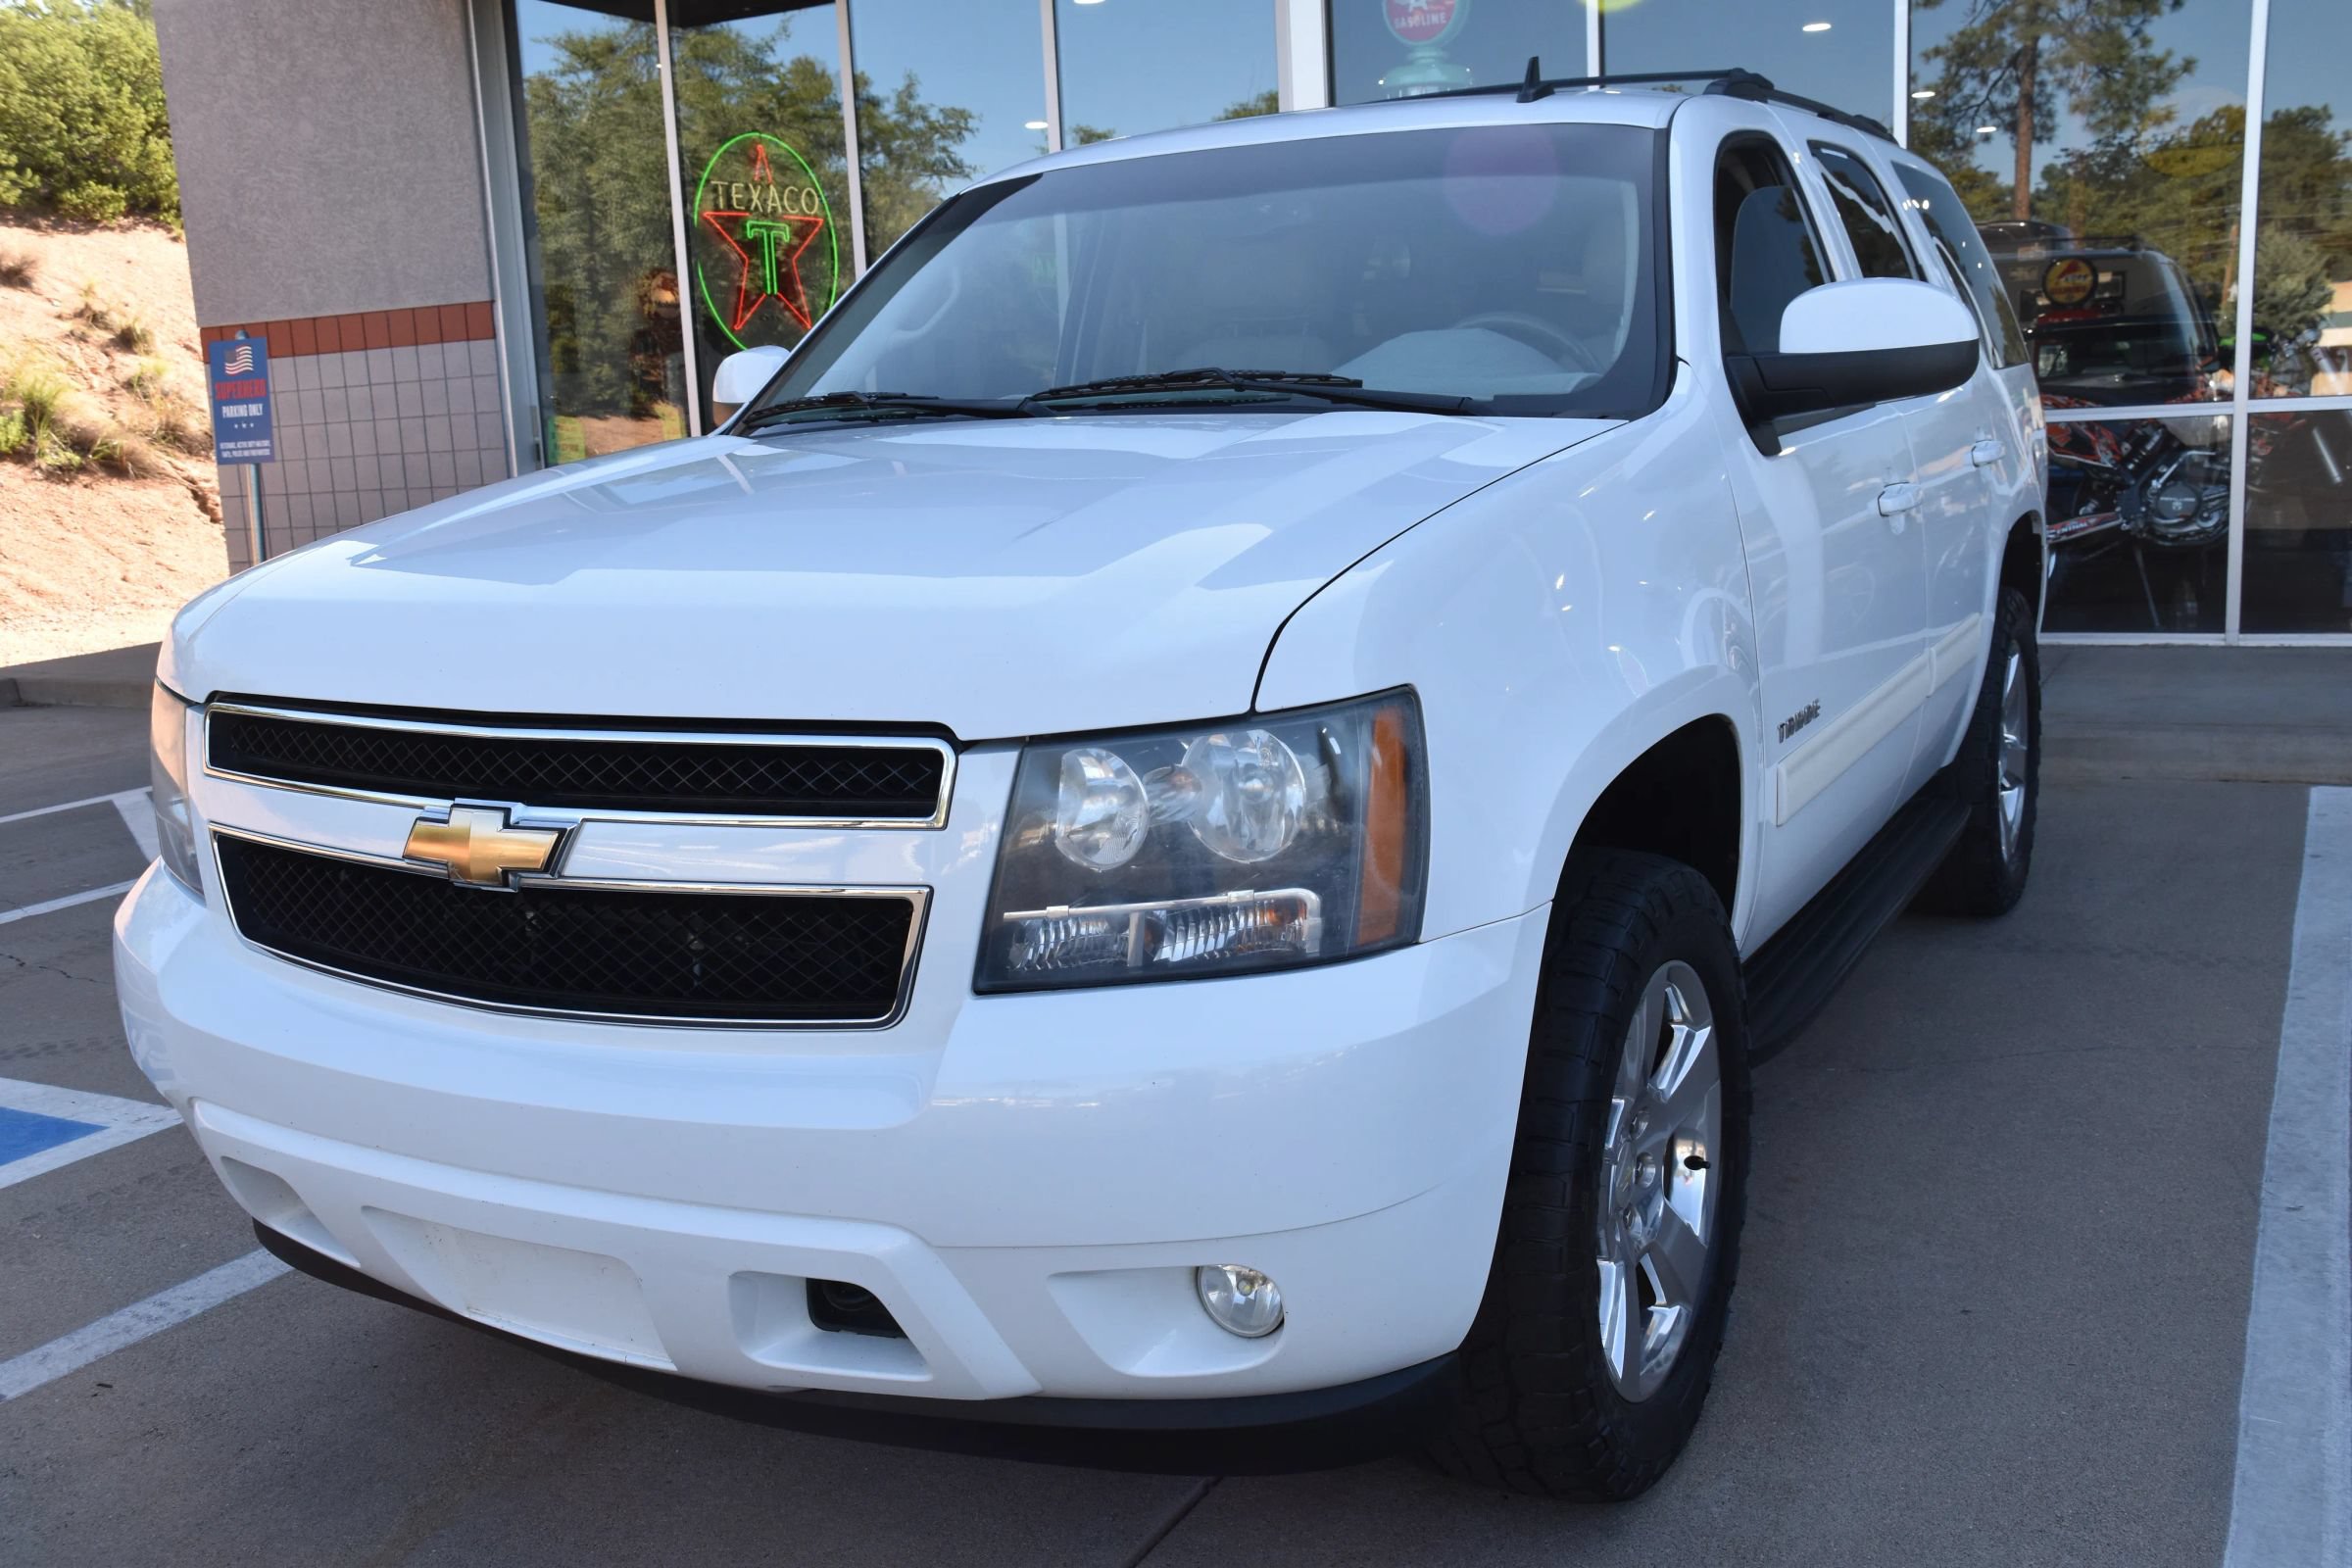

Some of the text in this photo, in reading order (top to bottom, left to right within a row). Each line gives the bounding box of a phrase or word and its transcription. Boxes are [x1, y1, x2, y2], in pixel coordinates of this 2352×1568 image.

[1394, 12, 1447, 29] GASOLINE
[710, 180, 819, 215] TEXACO
[746, 220, 790, 295] T
[221, 403, 264, 418] PARKING ONLY
